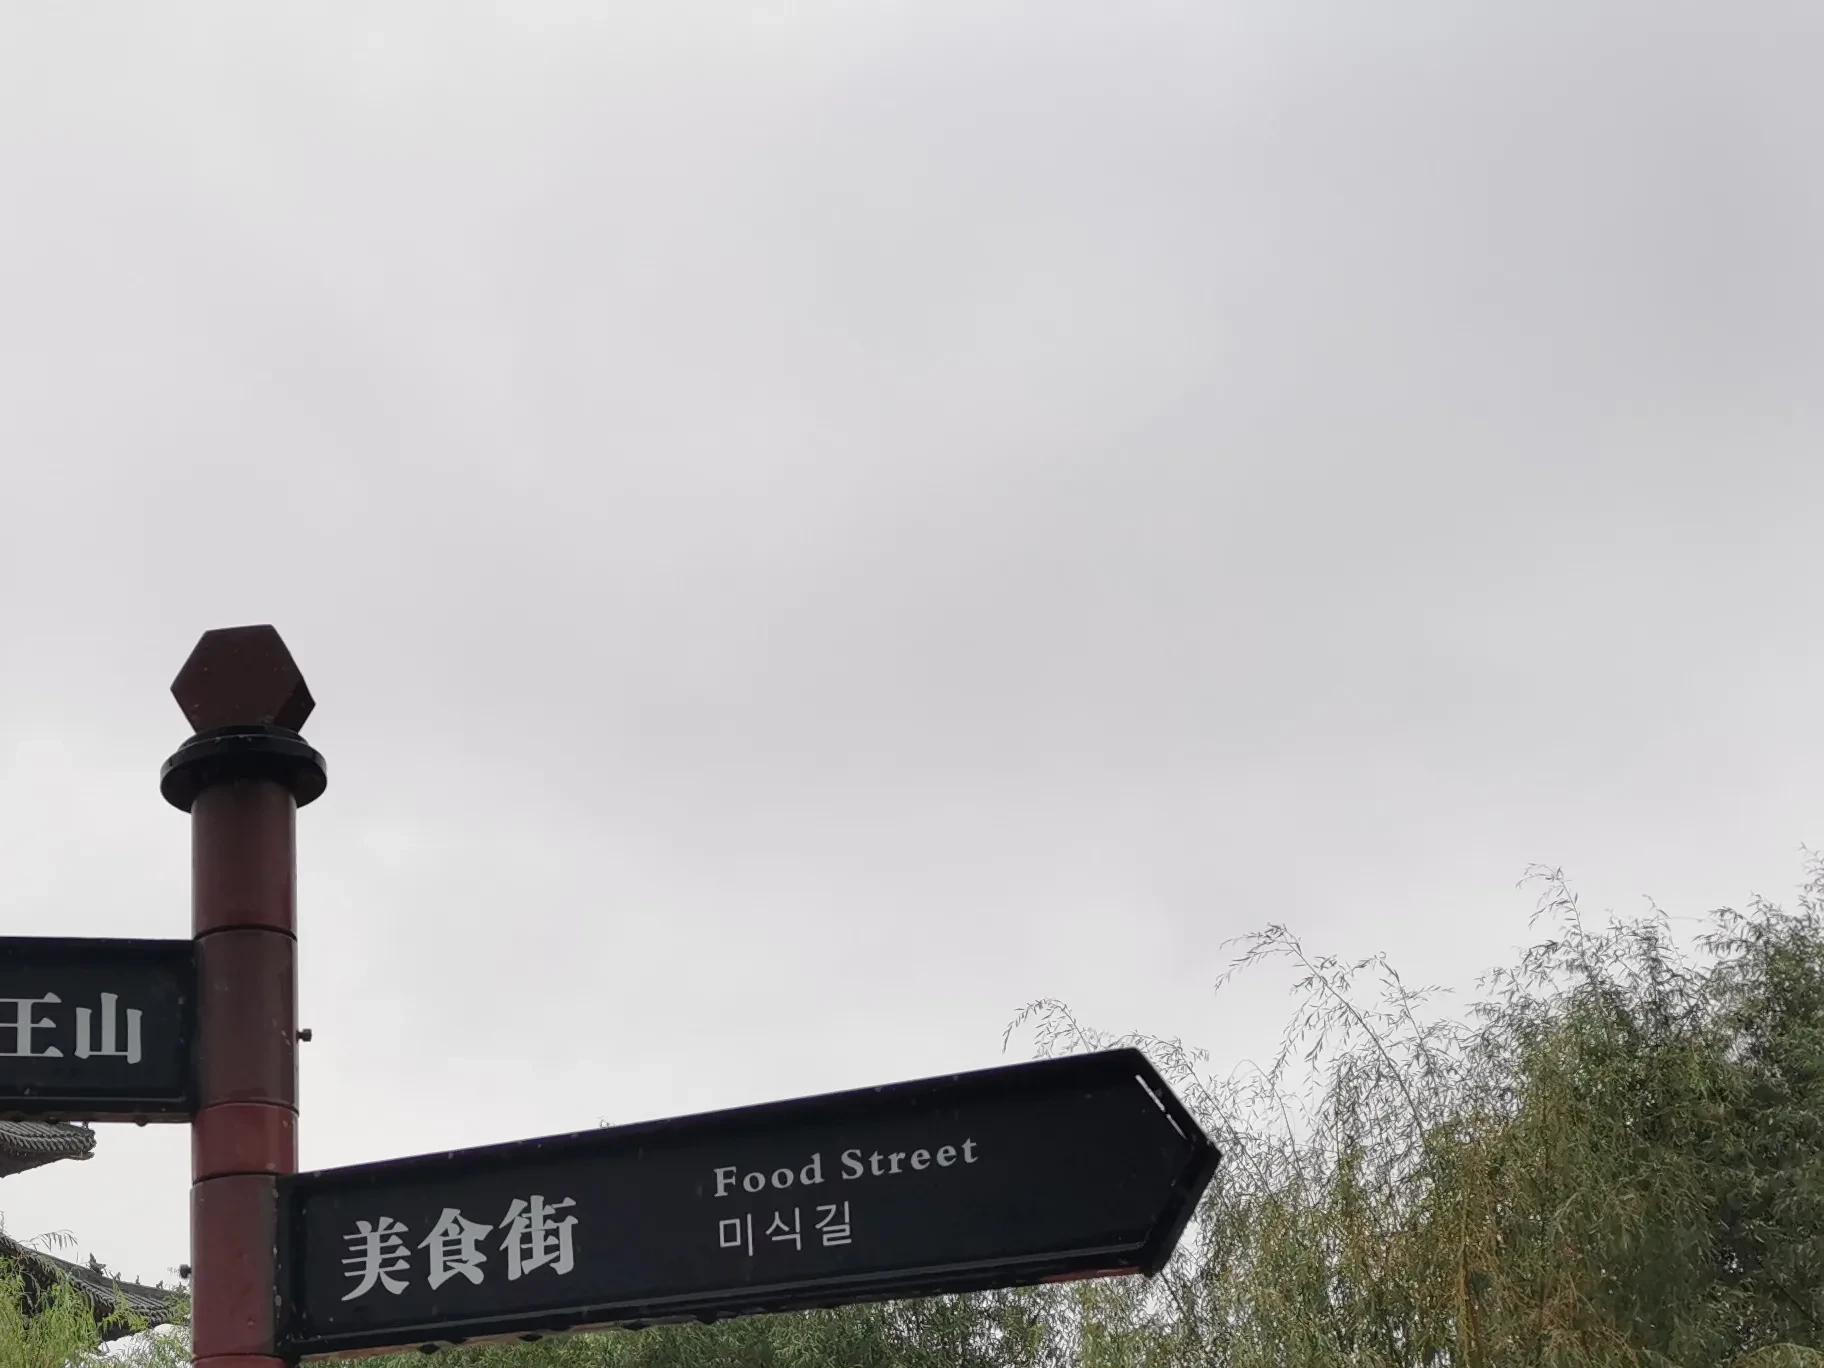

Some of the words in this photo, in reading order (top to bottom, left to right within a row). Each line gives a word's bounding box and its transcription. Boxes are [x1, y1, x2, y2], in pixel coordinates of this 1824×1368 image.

[714, 1153, 824, 1197] Food
[842, 1138, 978, 1179] Street
[341, 1195, 579, 1302] 美食街
[719, 1201, 854, 1257] 미식길
